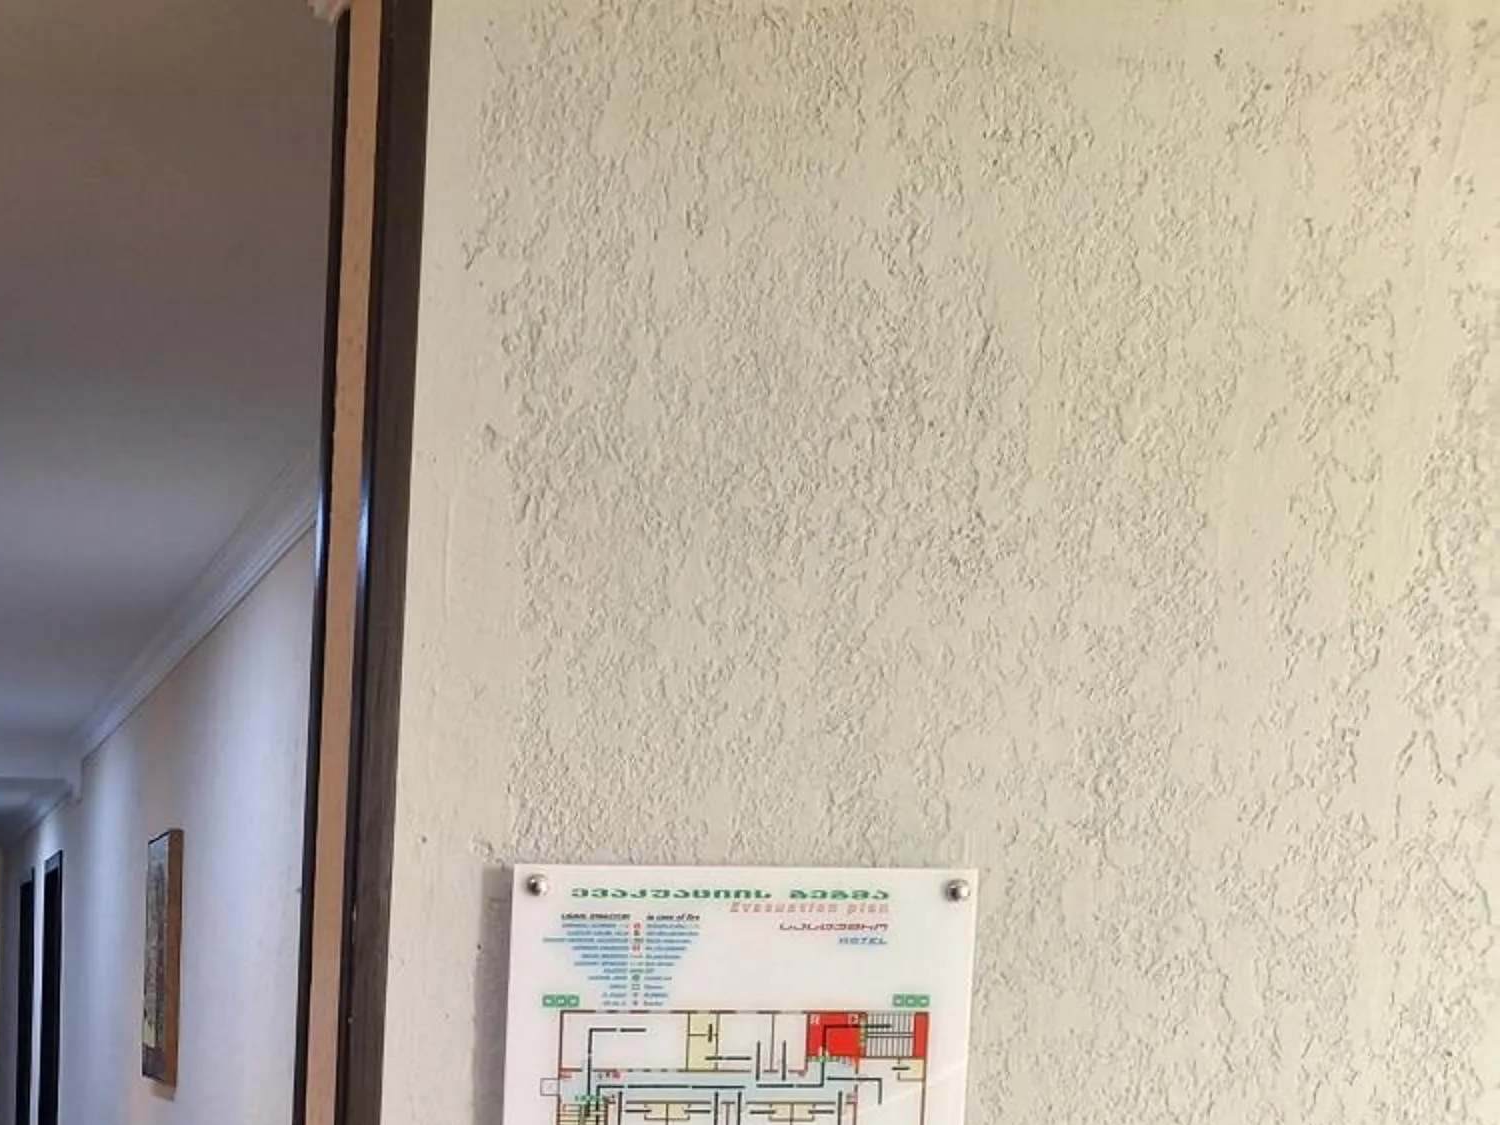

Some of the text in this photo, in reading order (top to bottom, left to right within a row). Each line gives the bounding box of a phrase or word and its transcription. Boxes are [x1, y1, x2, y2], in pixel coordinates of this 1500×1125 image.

[571, 888, 890, 899] ევაკუაციის გეგმა
[729, 902, 889, 914] Evacuation plan
[838, 937, 888, 945] HOTEL
